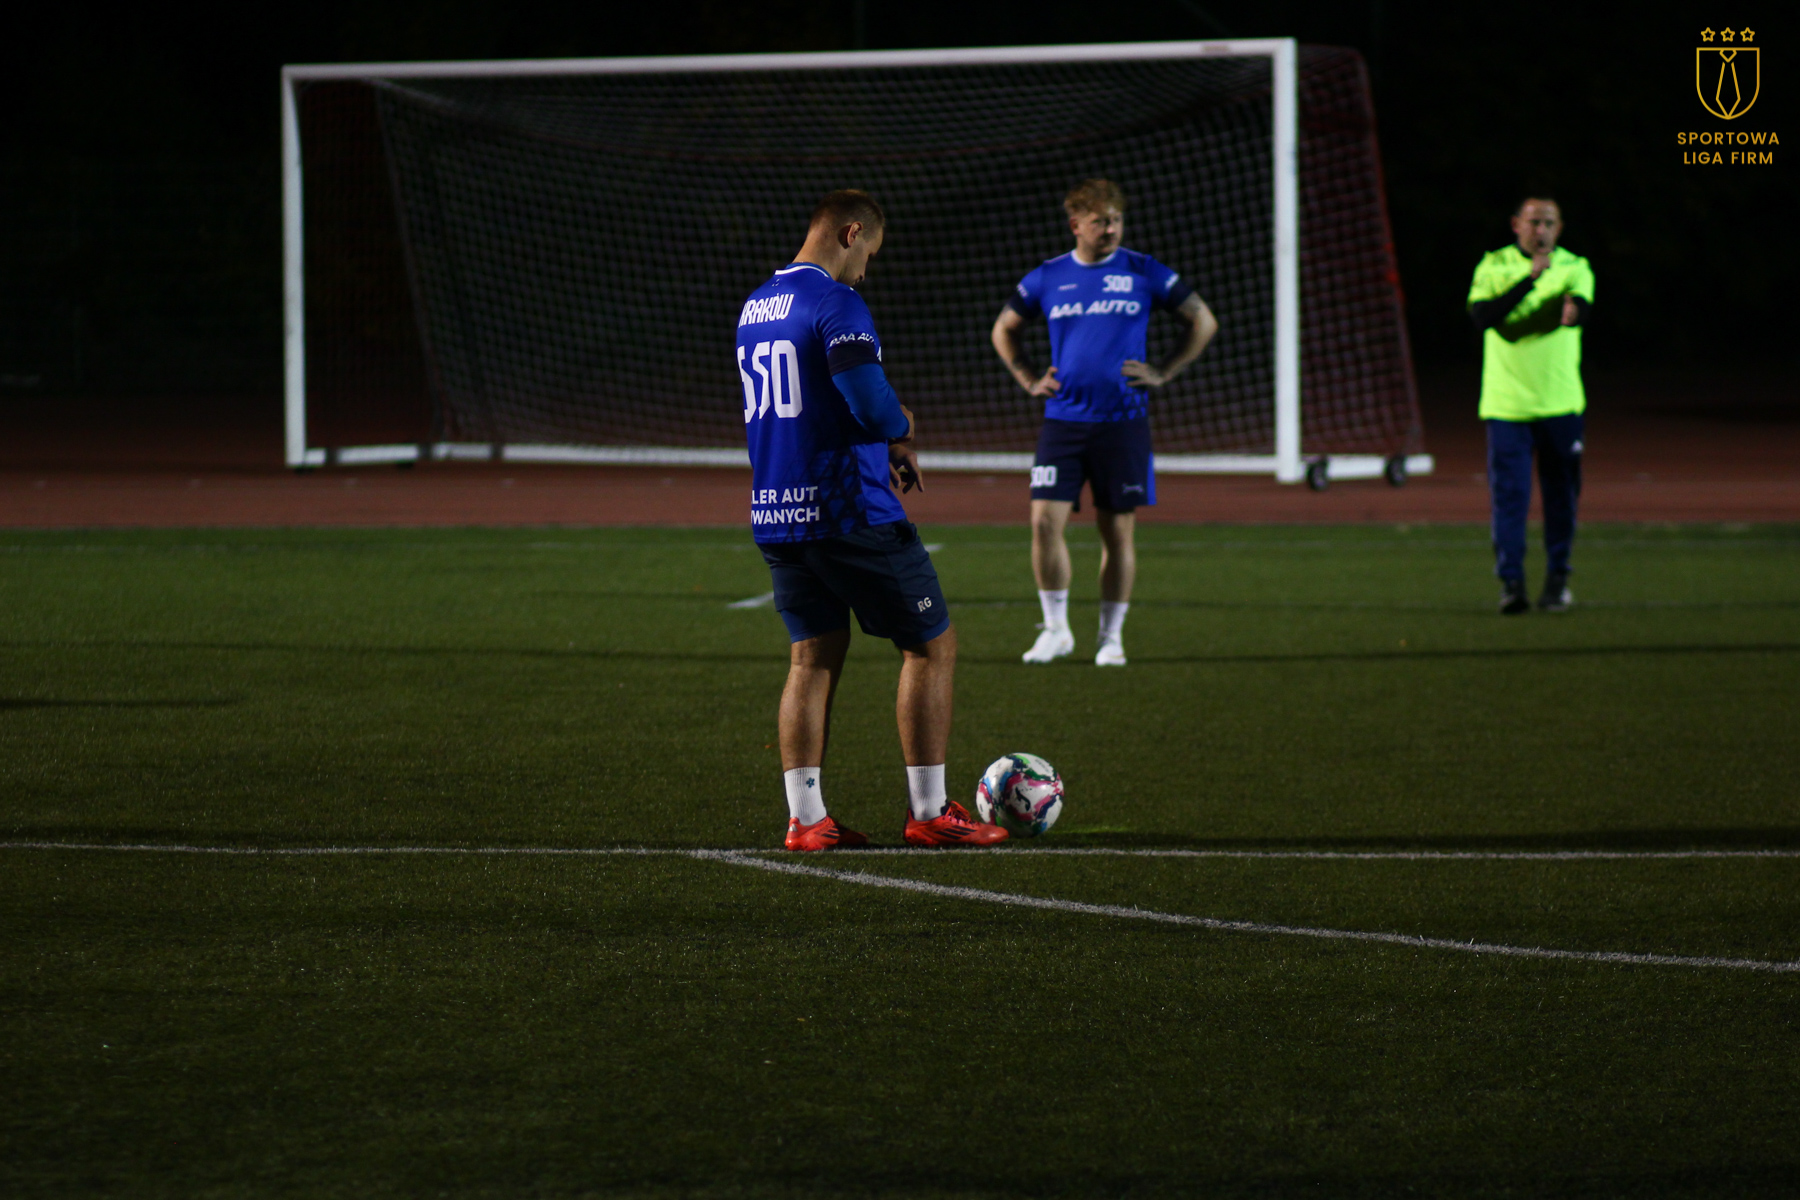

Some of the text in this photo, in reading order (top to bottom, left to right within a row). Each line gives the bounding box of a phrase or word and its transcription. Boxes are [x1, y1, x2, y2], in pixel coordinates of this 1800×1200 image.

[1102, 274, 1133, 293] 500
[1048, 299, 1141, 320] AAA AUTO
[751, 486, 818, 504] LER AUT
[750, 506, 820, 525] WANYCH
[917, 596, 932, 613] RG
